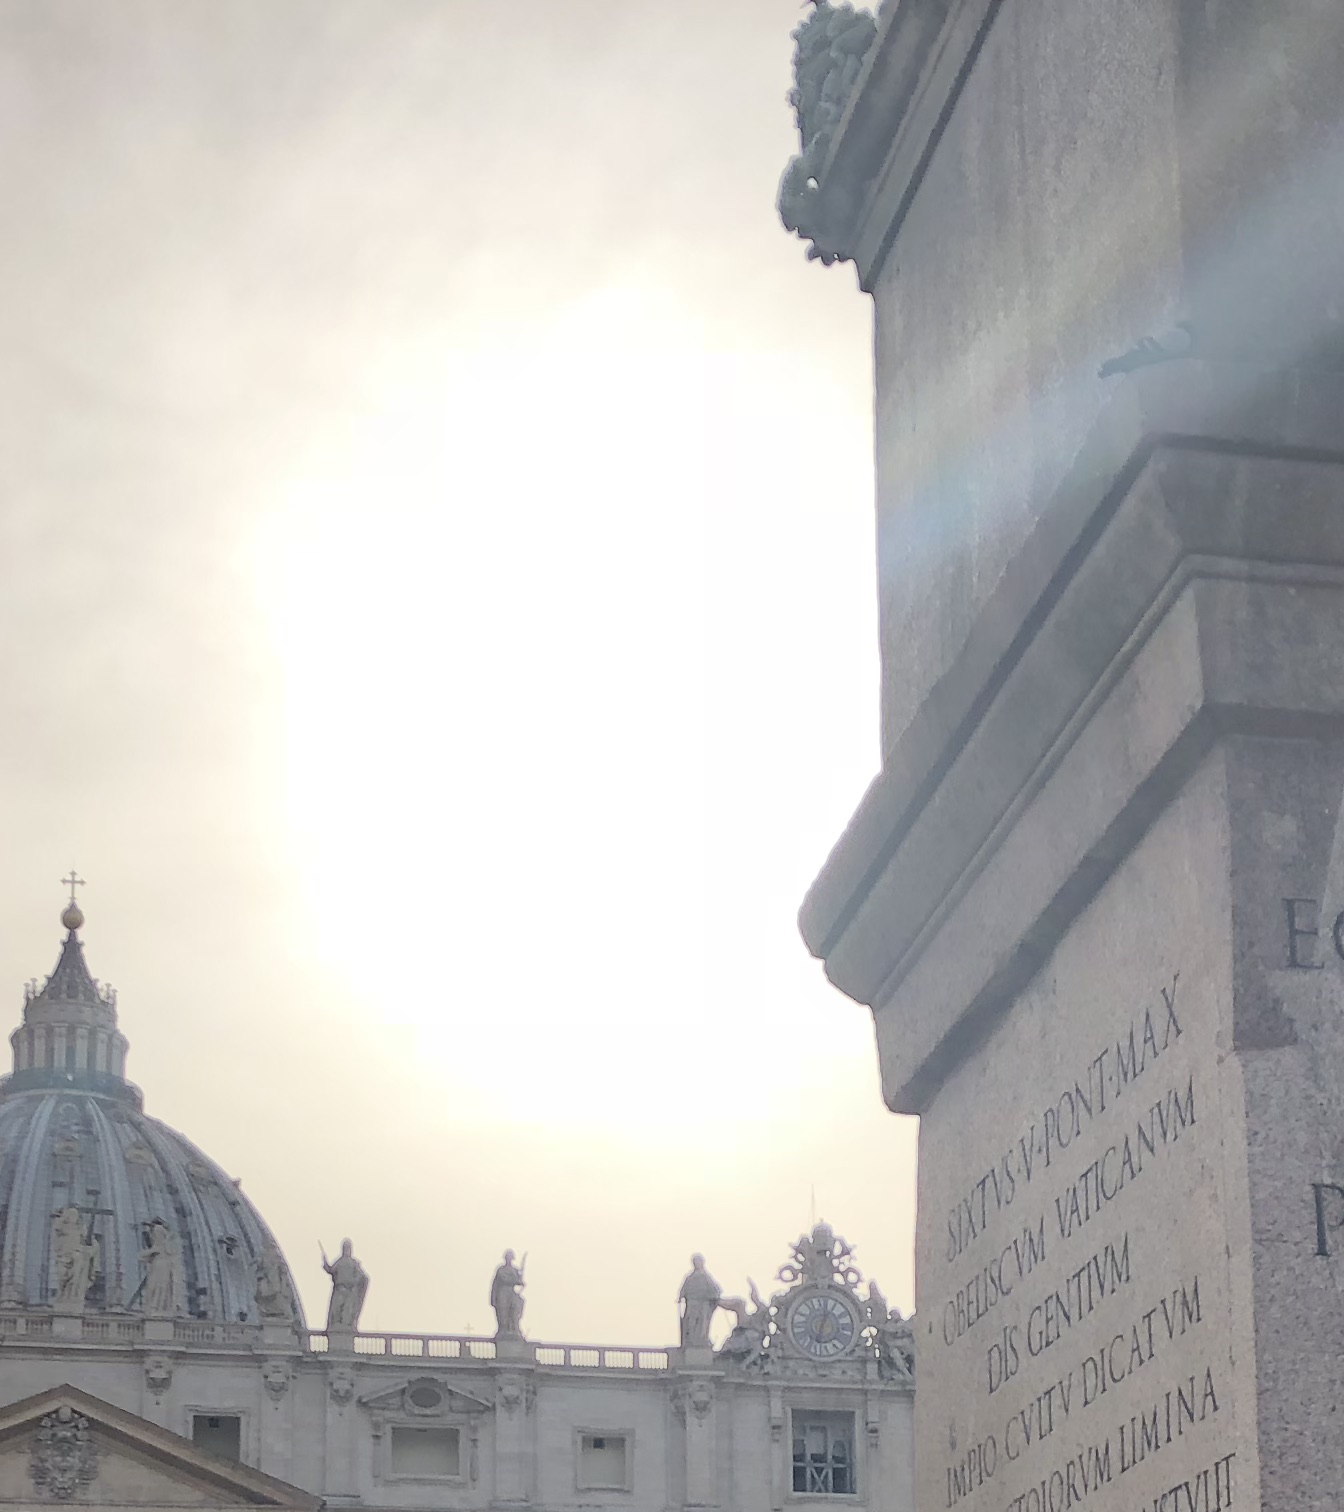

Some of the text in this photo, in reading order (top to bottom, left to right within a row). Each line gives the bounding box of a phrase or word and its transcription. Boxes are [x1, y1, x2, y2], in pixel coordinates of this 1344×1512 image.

[943, 1213, 1046, 1346] OBELISCVM
[1055, 1073, 1197, 1239] VATICANVM
[945, 1434, 997, 1509] IMPIO
[1081, 1275, 1202, 1407] DICATVM
[987, 1230, 1130, 1395] DIS GENTIVM
[1119, 1365, 1220, 1474] LIMINA
